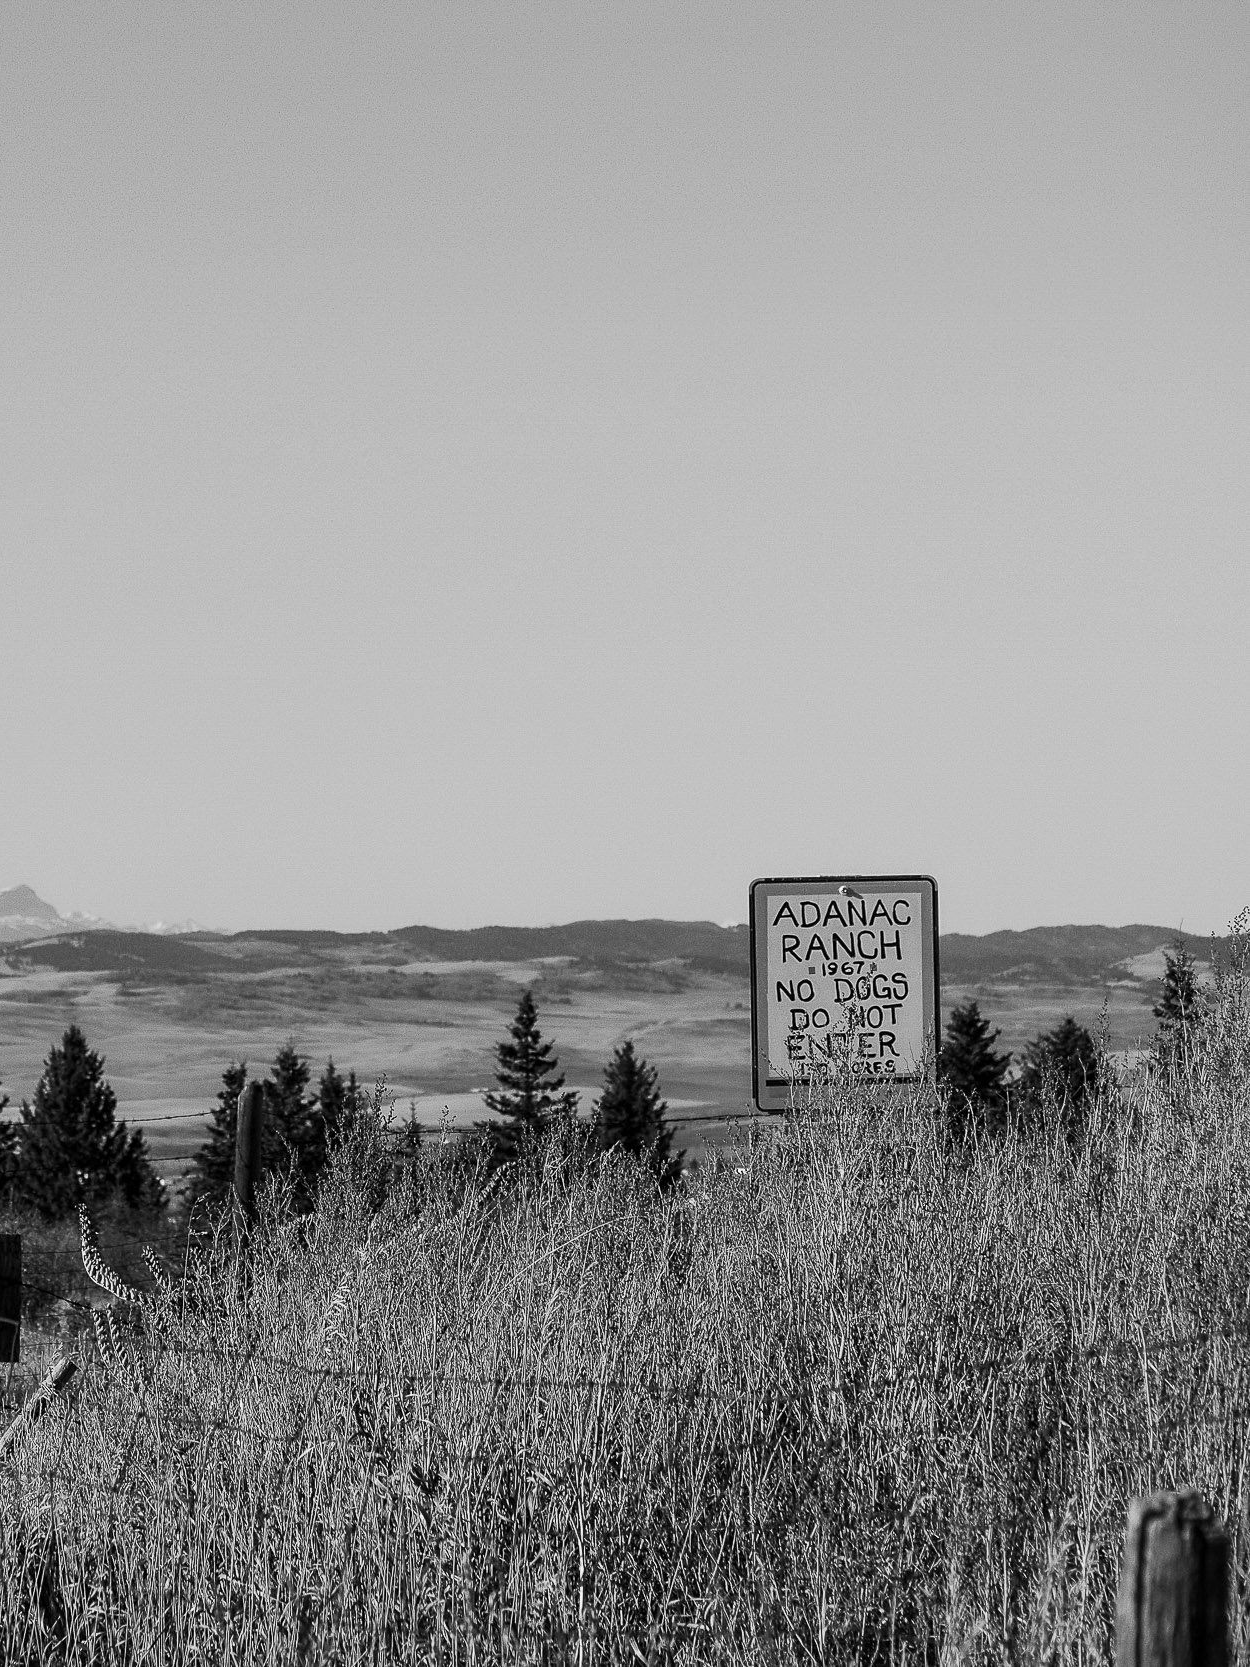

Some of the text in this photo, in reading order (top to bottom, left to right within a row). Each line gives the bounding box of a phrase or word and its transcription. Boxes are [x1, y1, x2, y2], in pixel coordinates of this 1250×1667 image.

[773, 900, 911, 927] ADANAC
[782, 931, 902, 963] RANCH
[822, 961, 865, 976] 1967
[776, 973, 909, 1003] NO DOGS
[790, 1004, 903, 1031] DO NOT
[787, 1031, 900, 1060] ENTER
